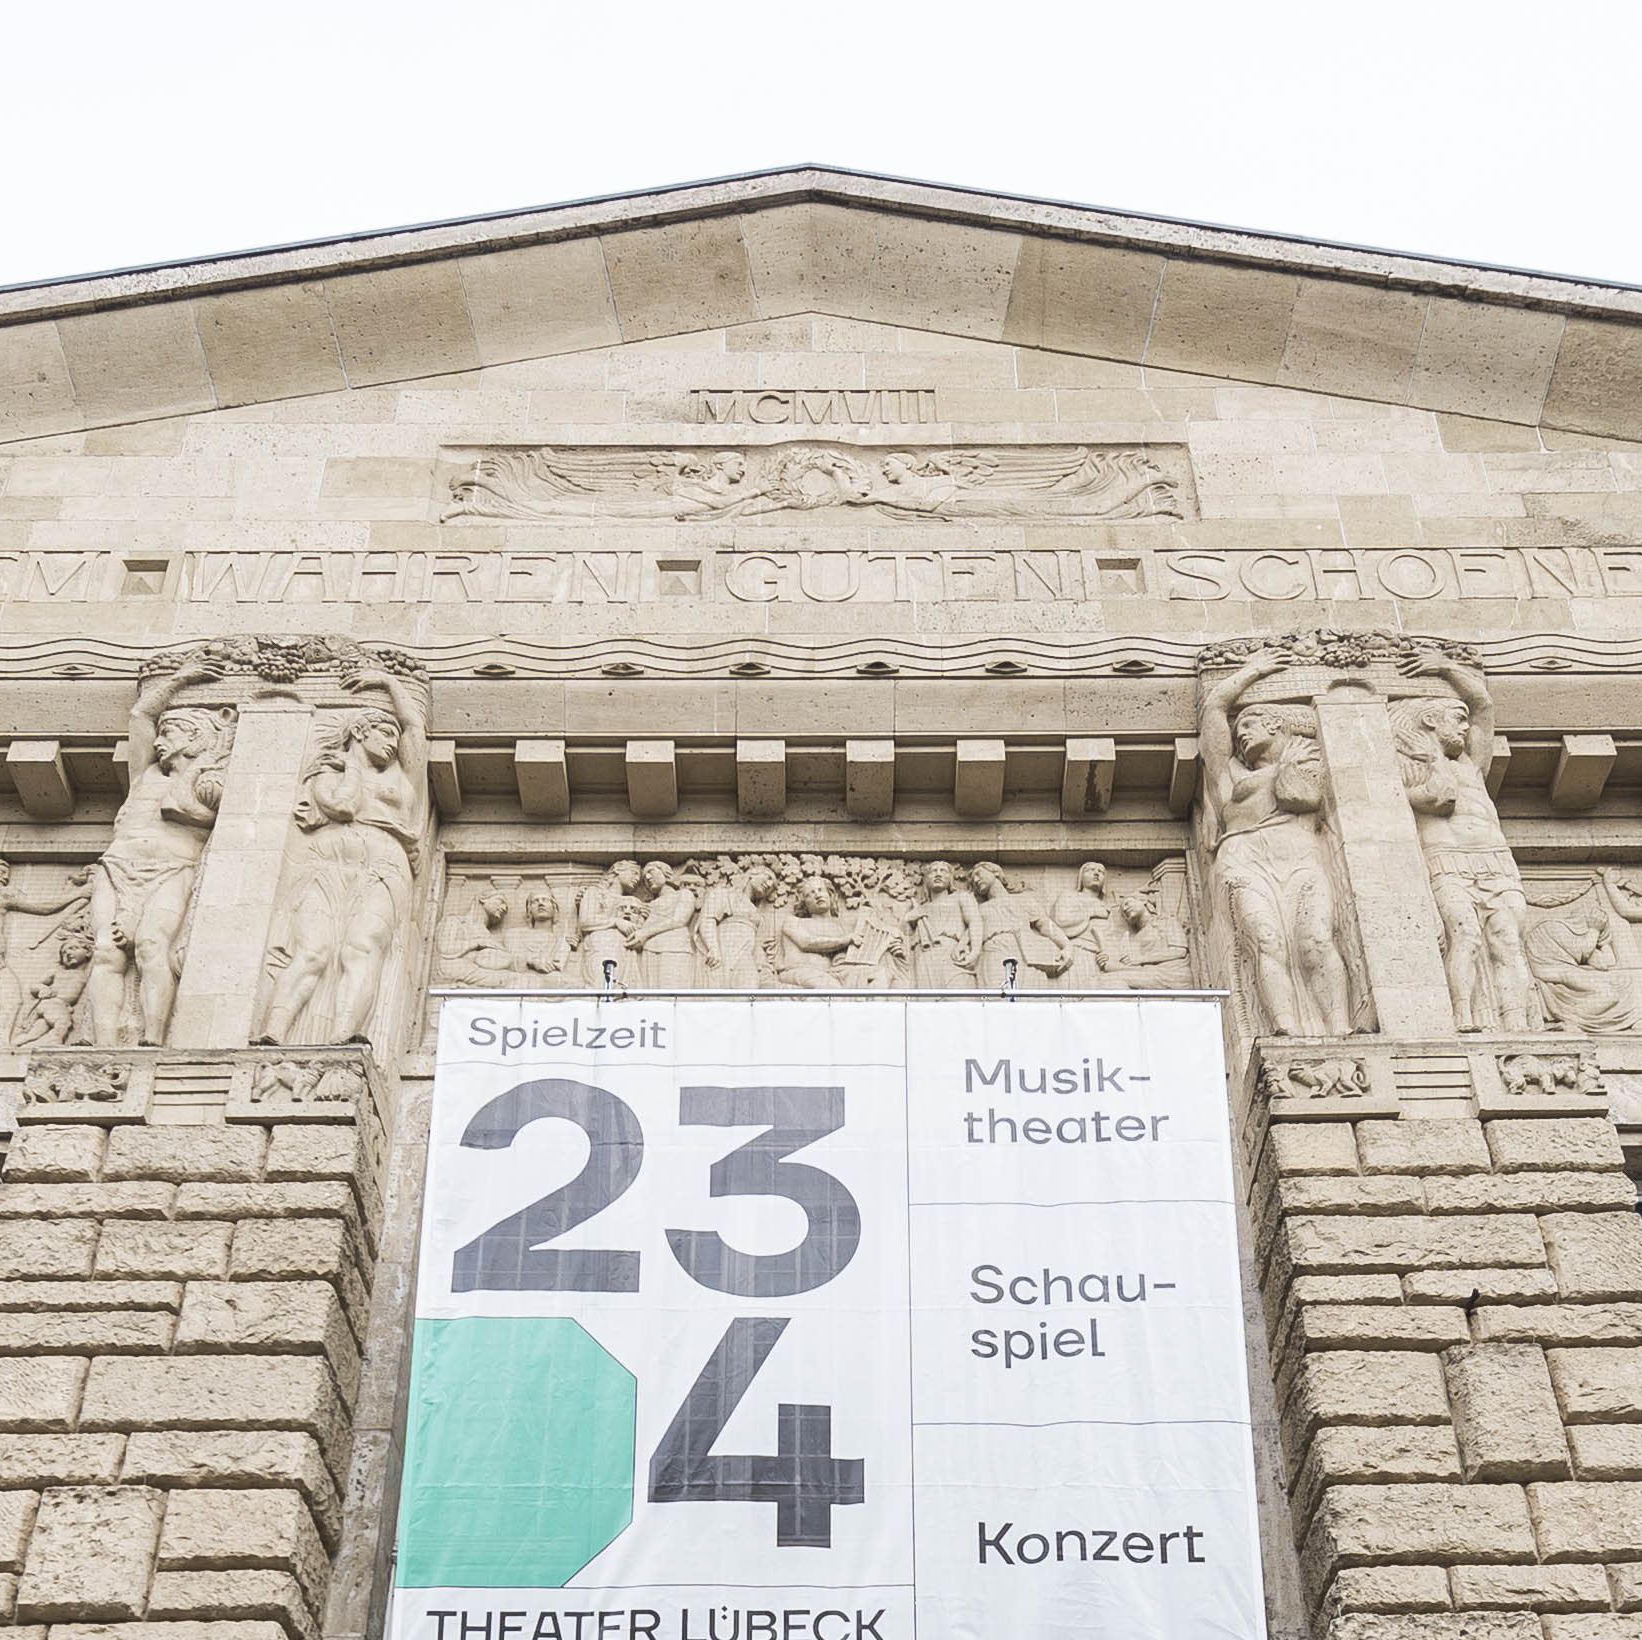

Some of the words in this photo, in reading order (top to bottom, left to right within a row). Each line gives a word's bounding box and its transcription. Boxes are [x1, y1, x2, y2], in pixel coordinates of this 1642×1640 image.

[696, 390, 929, 424] MCMVIII
[189, 551, 643, 601] WAHREN
[725, 550, 1084, 601] GUTEN
[467, 1017, 667, 1056] Spielzeit
[963, 1057, 1152, 1096] Musik-
[962, 1105, 1170, 1145] theater
[450, 1078, 862, 1298] 23
[970, 1263, 1177, 1304] Schau-
[970, 1316, 1107, 1369] spiel
[647, 1316, 865, 1548] 4
[976, 1520, 1206, 1565] Konzert
